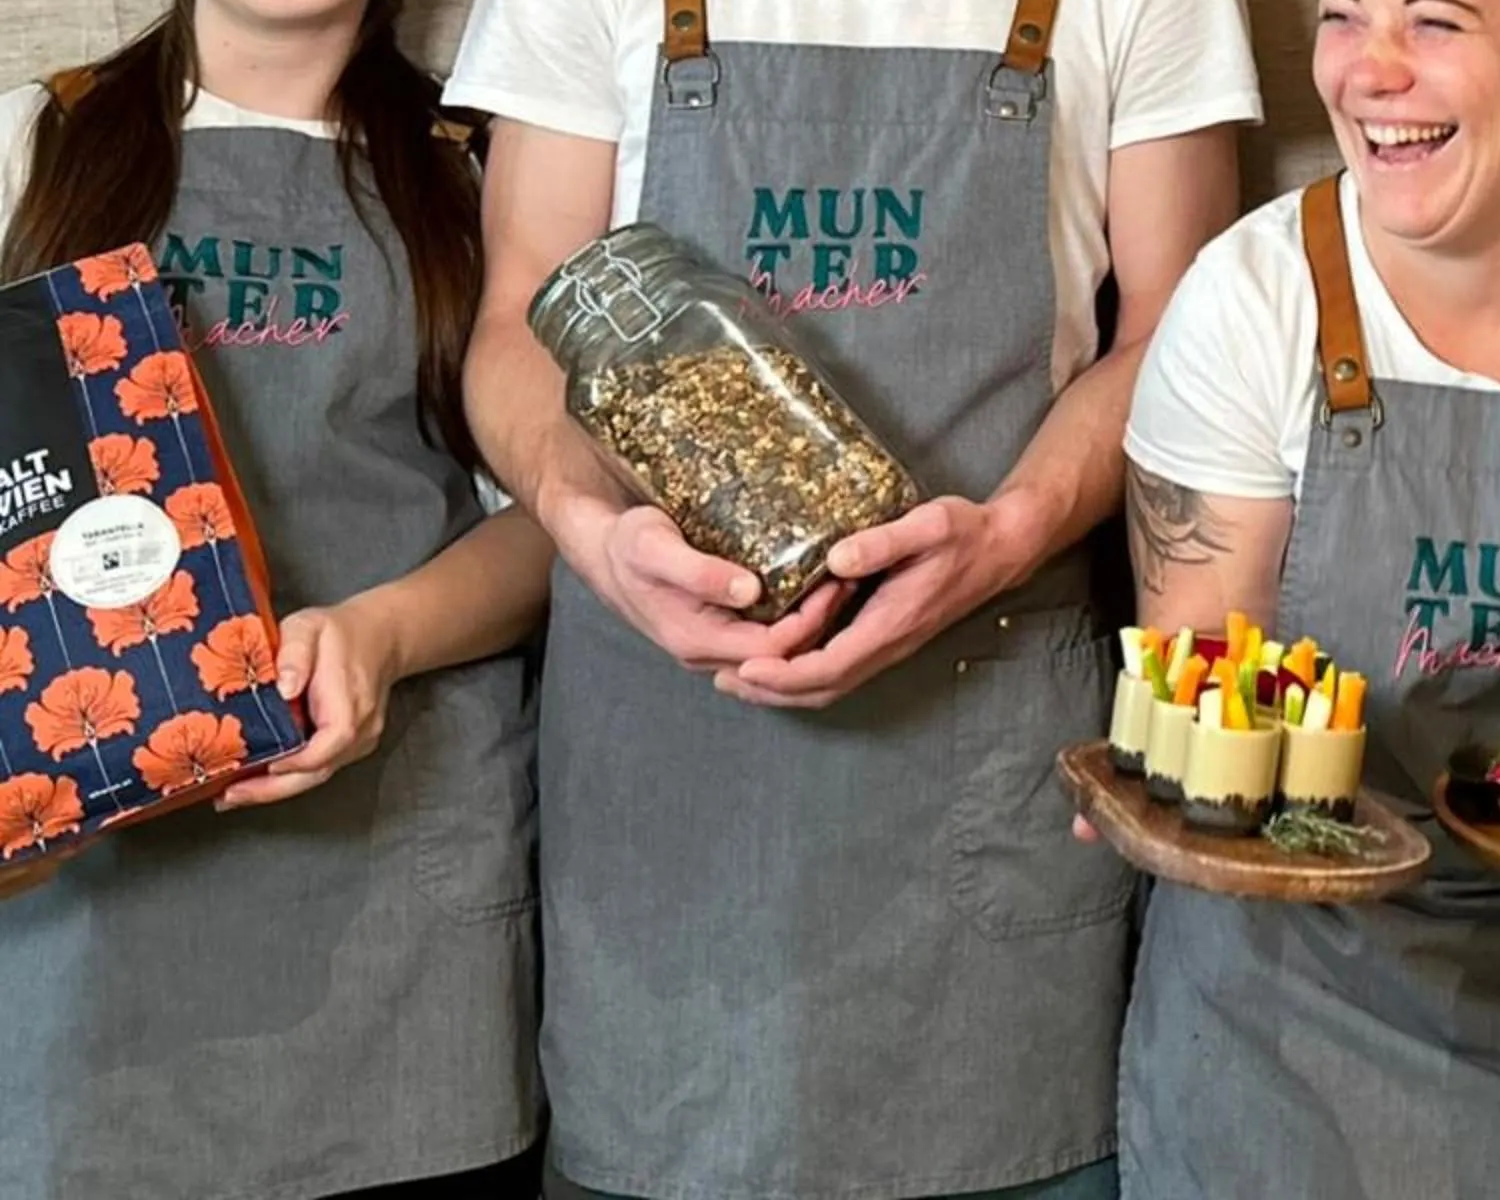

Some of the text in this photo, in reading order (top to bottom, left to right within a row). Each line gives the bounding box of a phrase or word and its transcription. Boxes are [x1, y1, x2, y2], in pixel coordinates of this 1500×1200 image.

[747, 187, 925, 239] MUN
[158, 233, 343, 280] MUN
[745, 244, 919, 294] TER
[161, 277, 342, 334] TER
